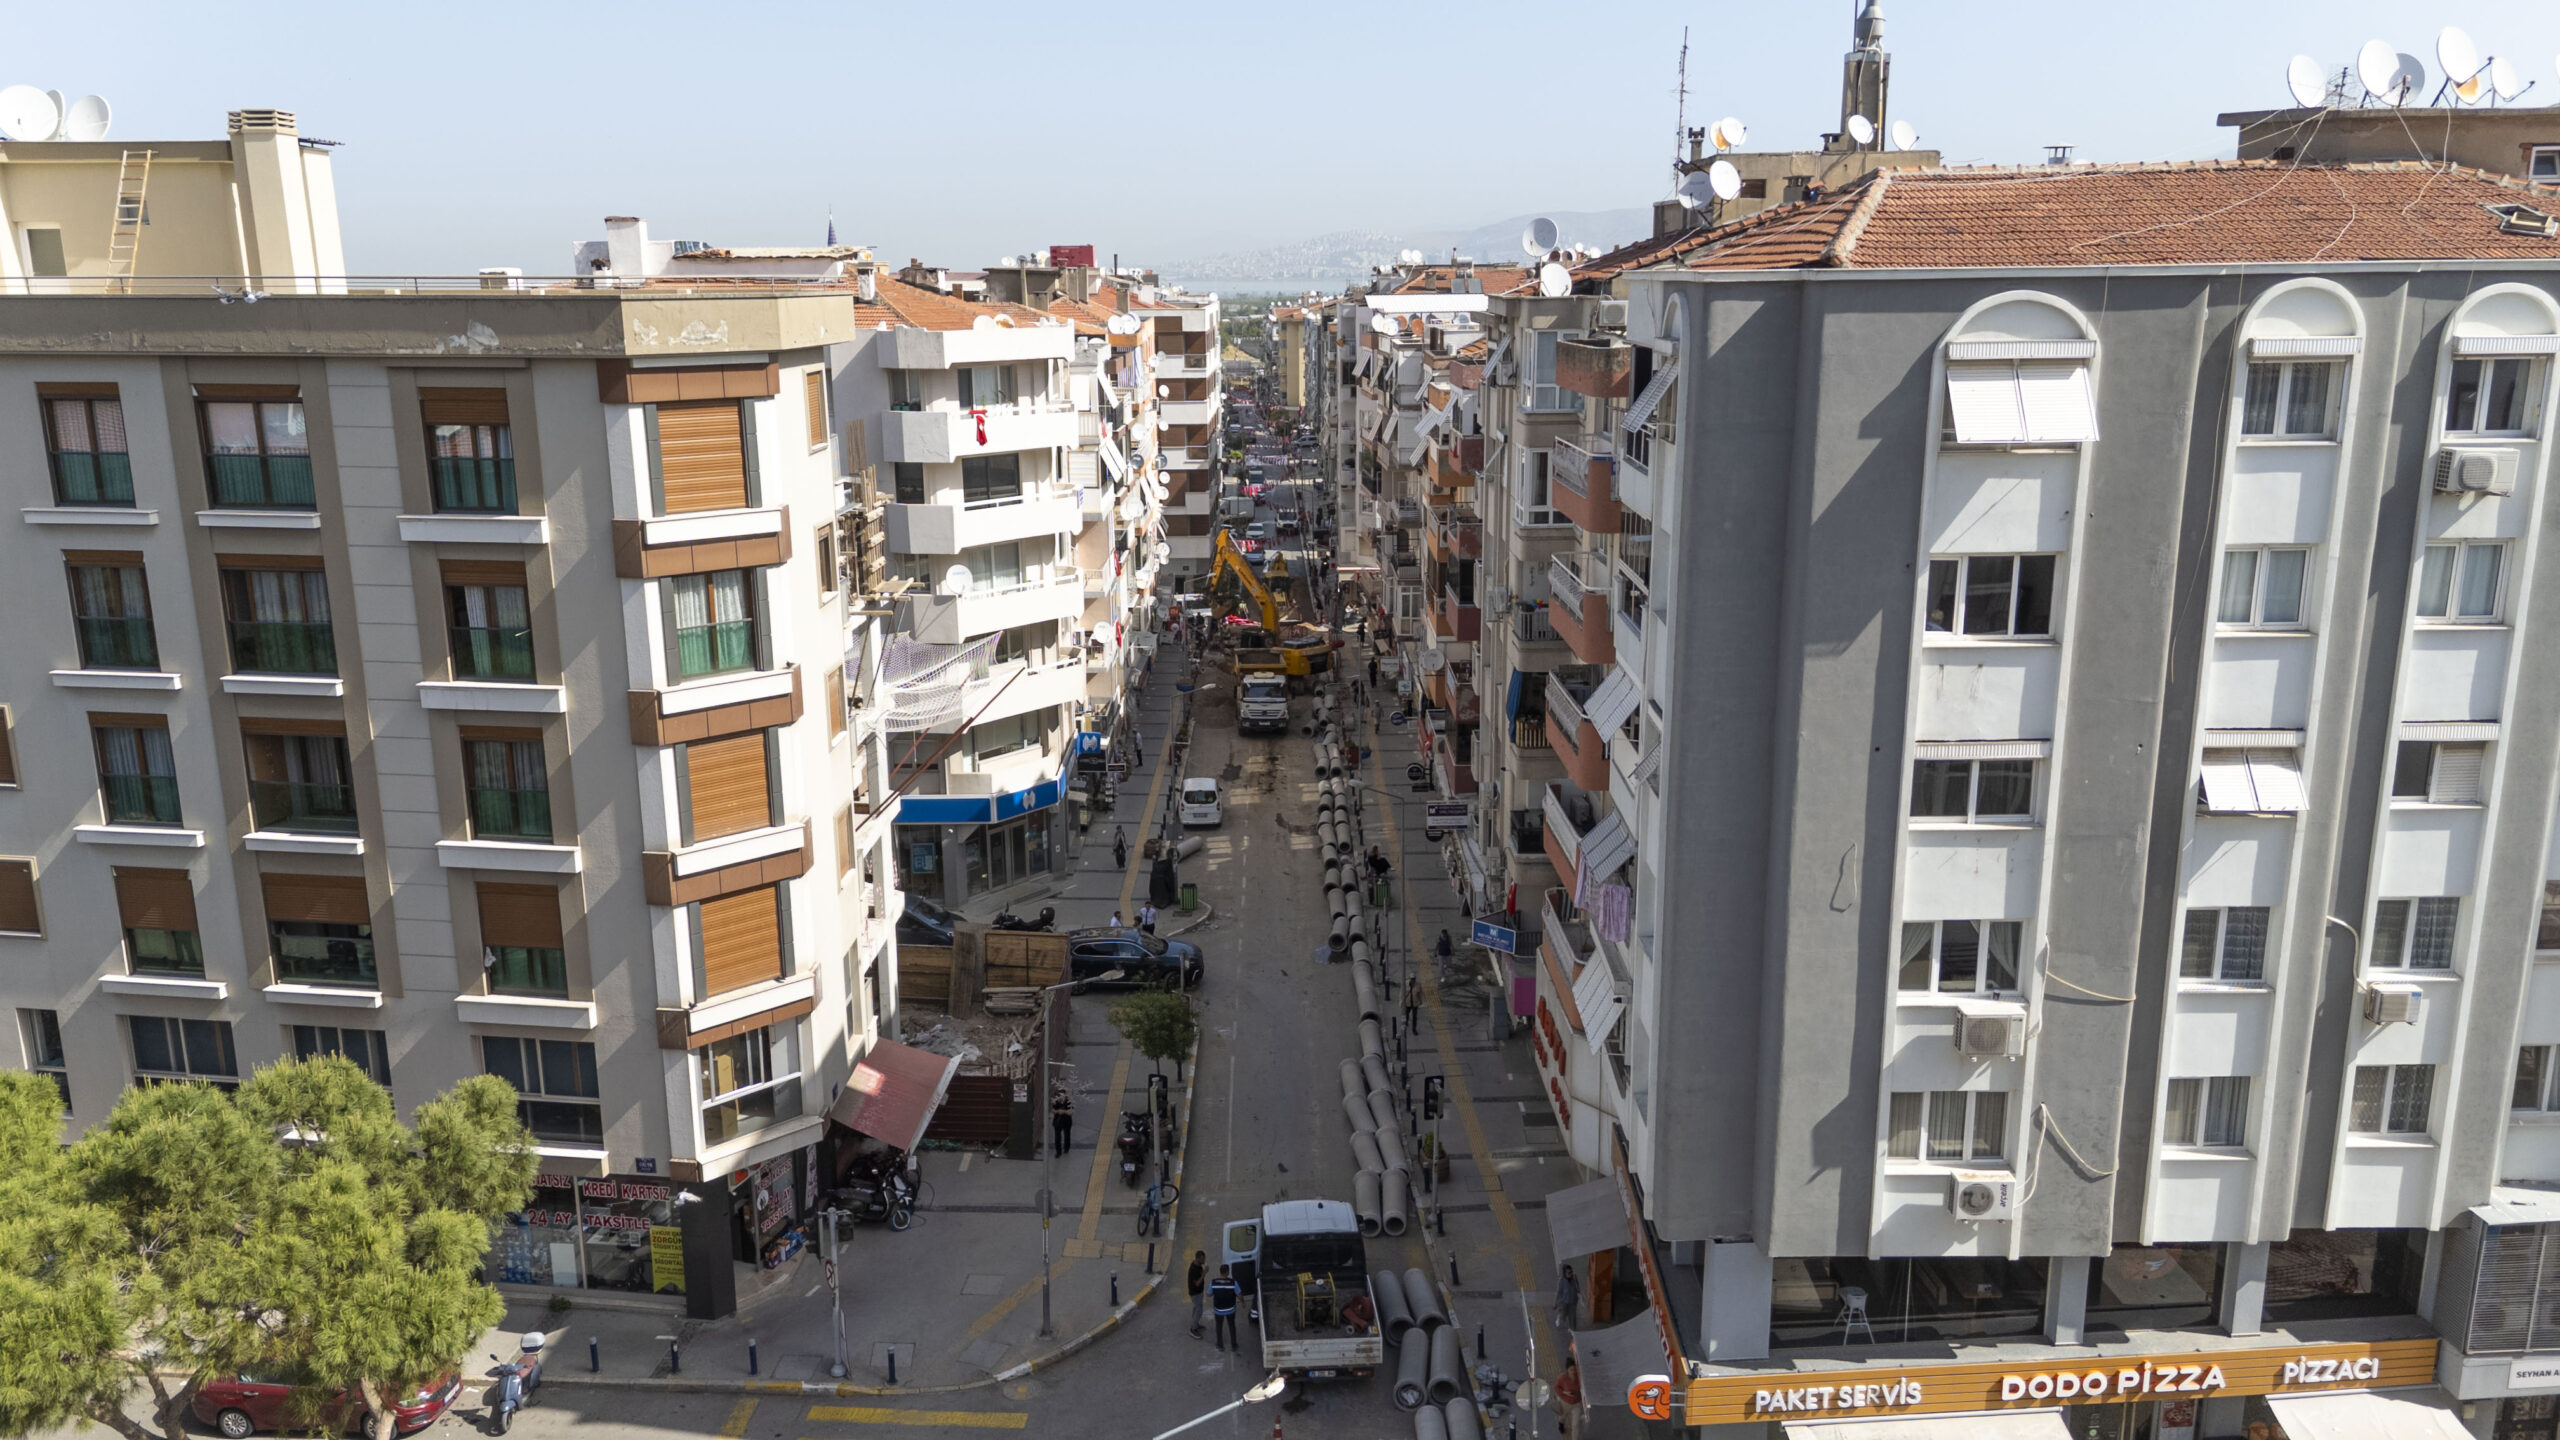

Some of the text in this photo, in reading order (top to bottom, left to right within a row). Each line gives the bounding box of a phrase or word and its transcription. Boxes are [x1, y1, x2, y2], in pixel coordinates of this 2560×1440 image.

[583, 1179, 671, 1201] KREDİ KARTSIZ
[527, 1208, 572, 1226] 24 AY
[586, 1212, 651, 1231] TAKSİTLE
[2001, 1361, 2226, 1401] DODO PİZZA
[2283, 1355, 2380, 1385] PİZZACI
[2515, 1369, 2552, 1379] SEYHAN
[1755, 1377, 1922, 1413] PAKET SERVİS
